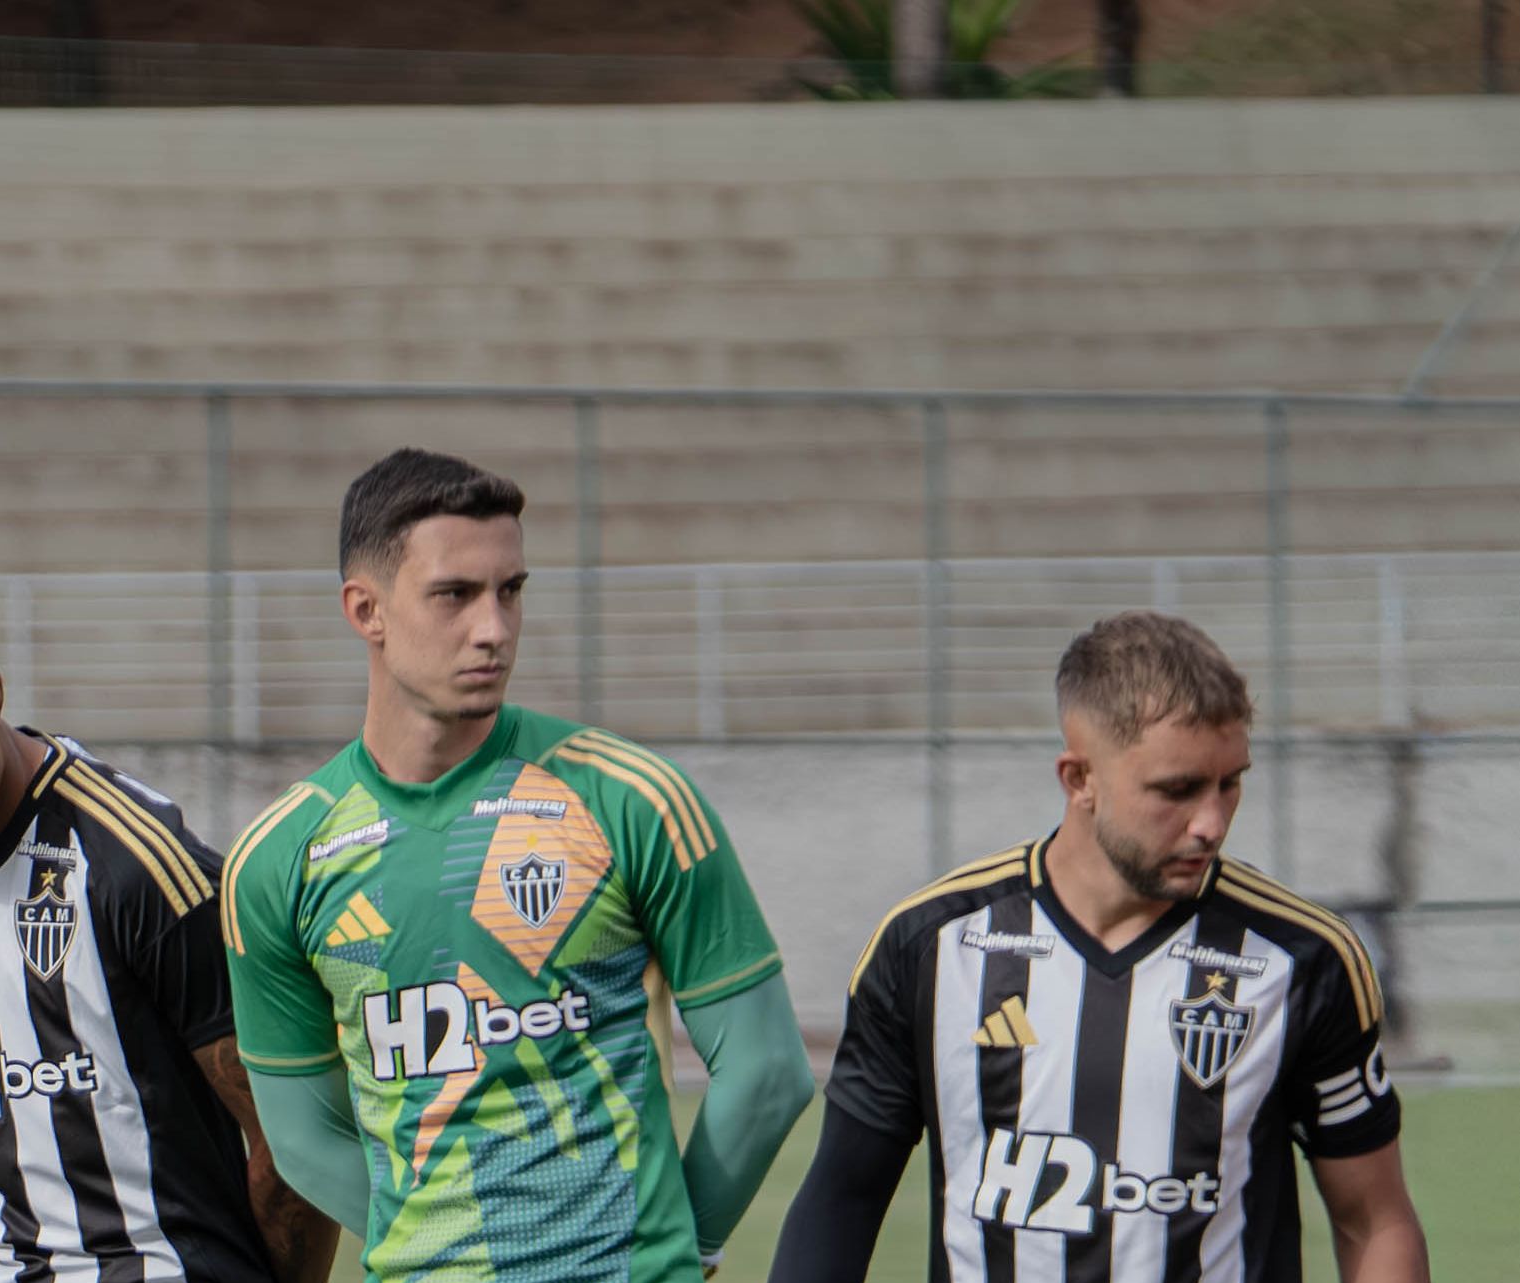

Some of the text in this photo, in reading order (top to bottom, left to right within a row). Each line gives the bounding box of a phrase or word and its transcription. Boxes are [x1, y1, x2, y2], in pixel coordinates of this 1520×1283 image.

[509, 866, 559, 881] CAM
[24, 907, 70, 922] CAM
[1180, 1010, 1245, 1028] CAM
